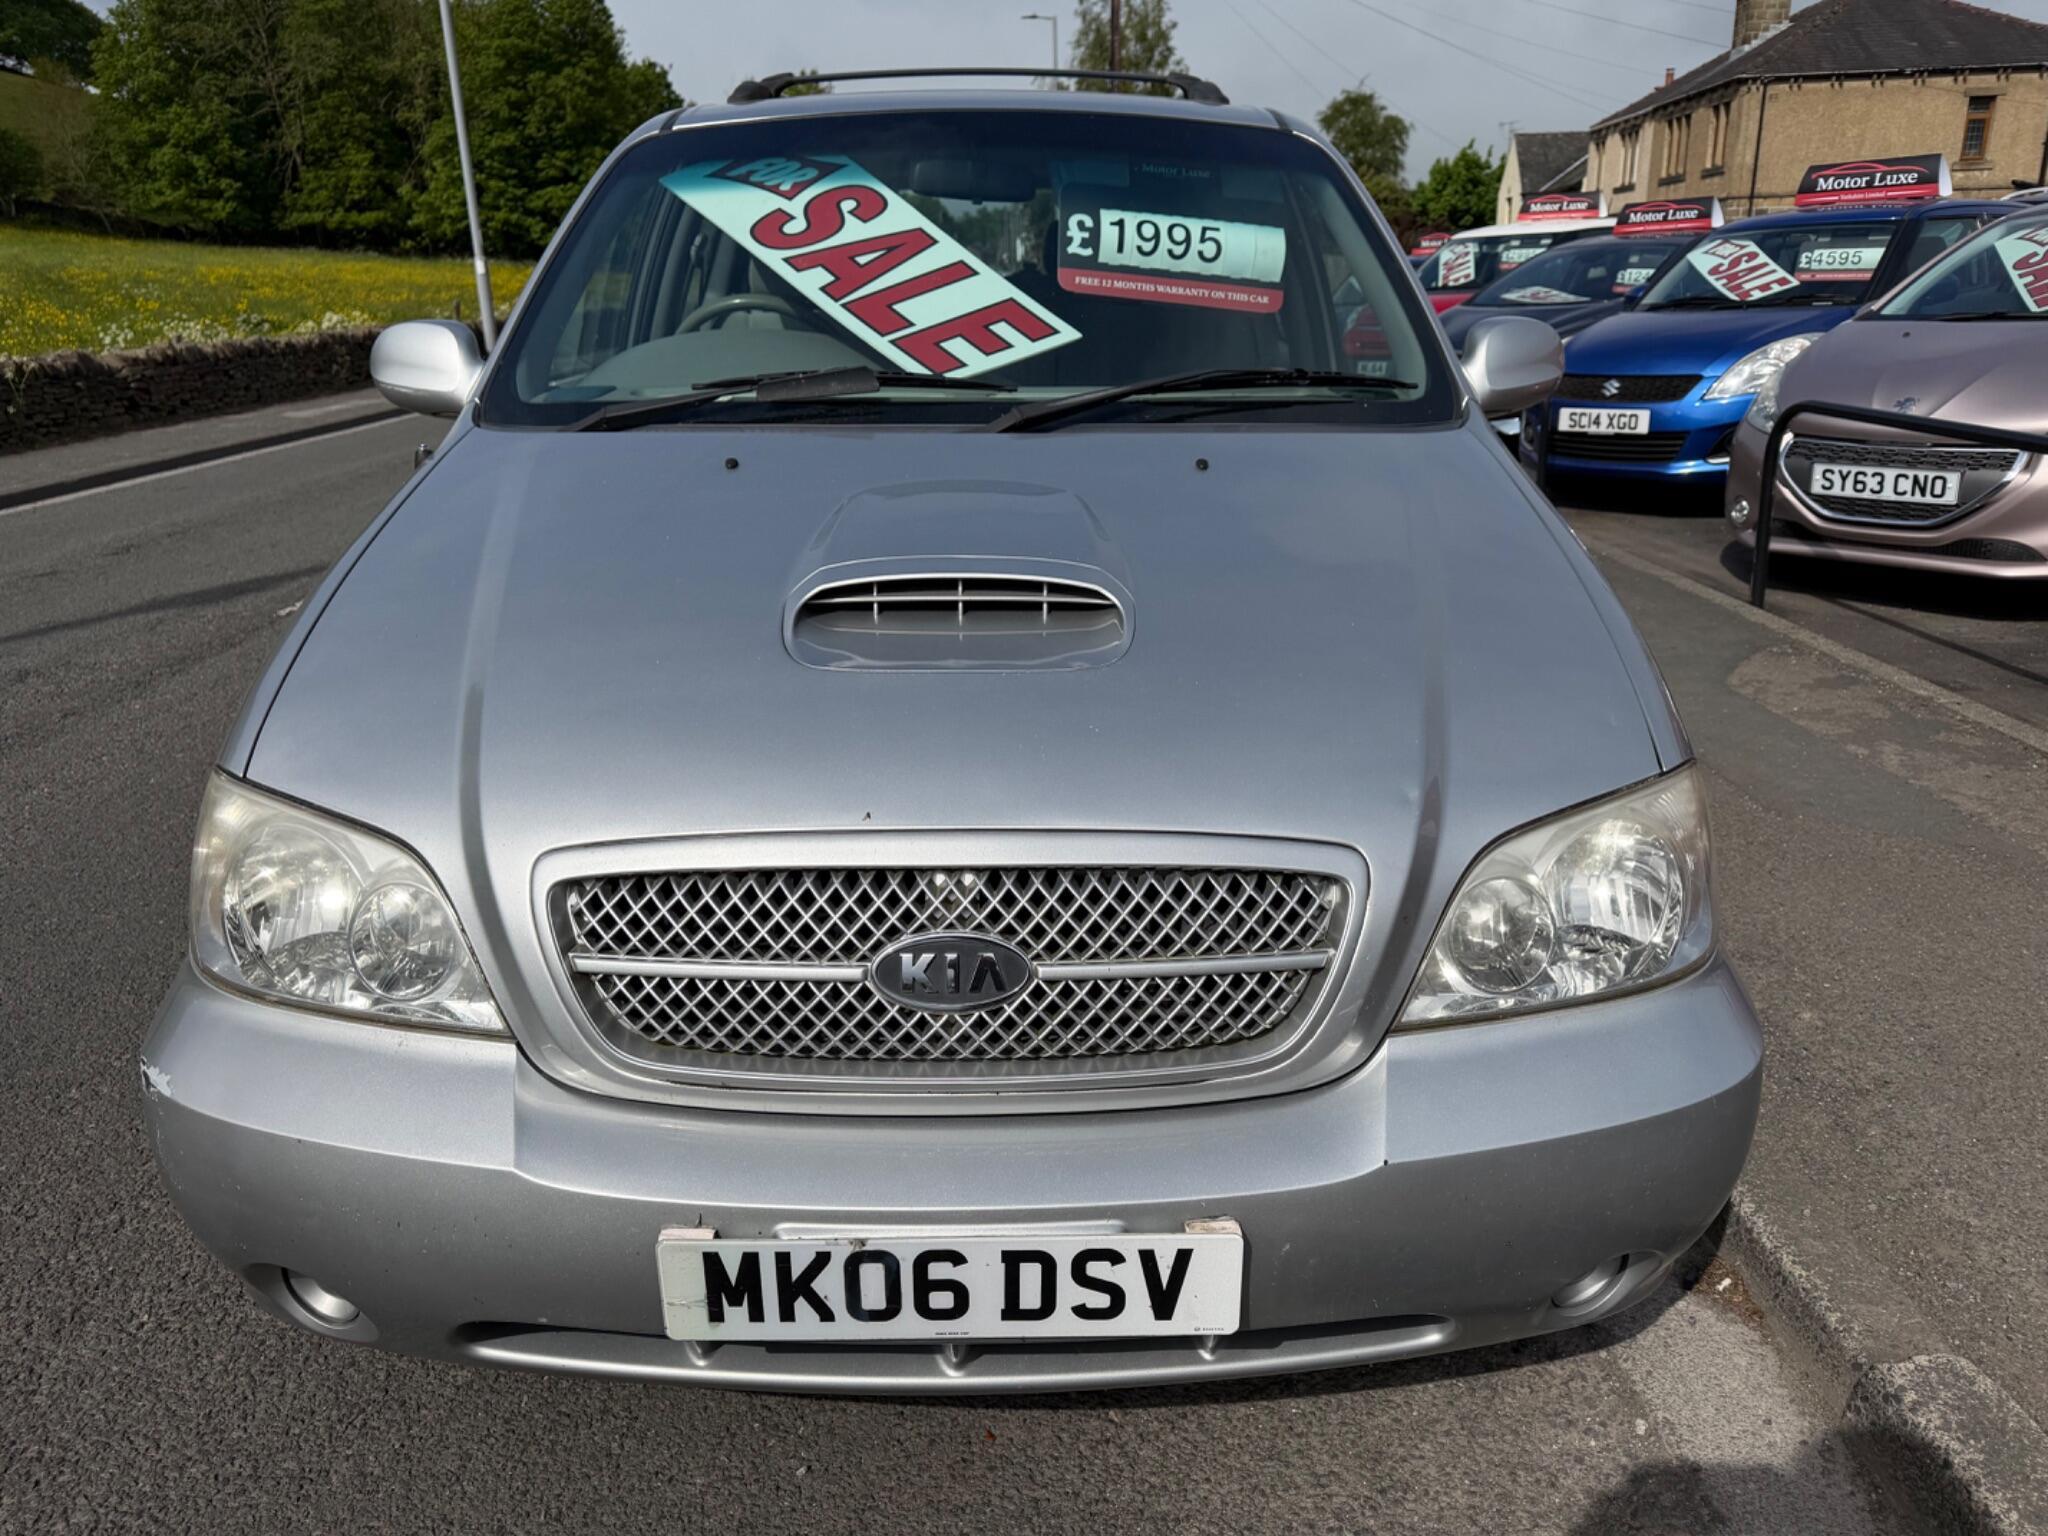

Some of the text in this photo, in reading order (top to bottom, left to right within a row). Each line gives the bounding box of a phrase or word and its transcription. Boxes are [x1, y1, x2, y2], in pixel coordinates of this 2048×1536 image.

[727, 157, 819, 191] FOR
[1816, 171, 1919, 192] Motor Luxe
[1529, 200, 1589, 213] Motor Luxe
[1628, 209, 1699, 224] Motor Luxe
[750, 184, 1059, 377] SALE
[1074, 276, 1270, 304] FREE 12 MONTHS WARRANTY ON THIS CAR
[1707, 251, 1793, 302] SALE
[1568, 411, 1602, 430] SC14
[1821, 470, 1948, 499] SY63 CNO
[899, 952, 1008, 994] KIA
[702, 1247, 1195, 1324] MK06 DSV
